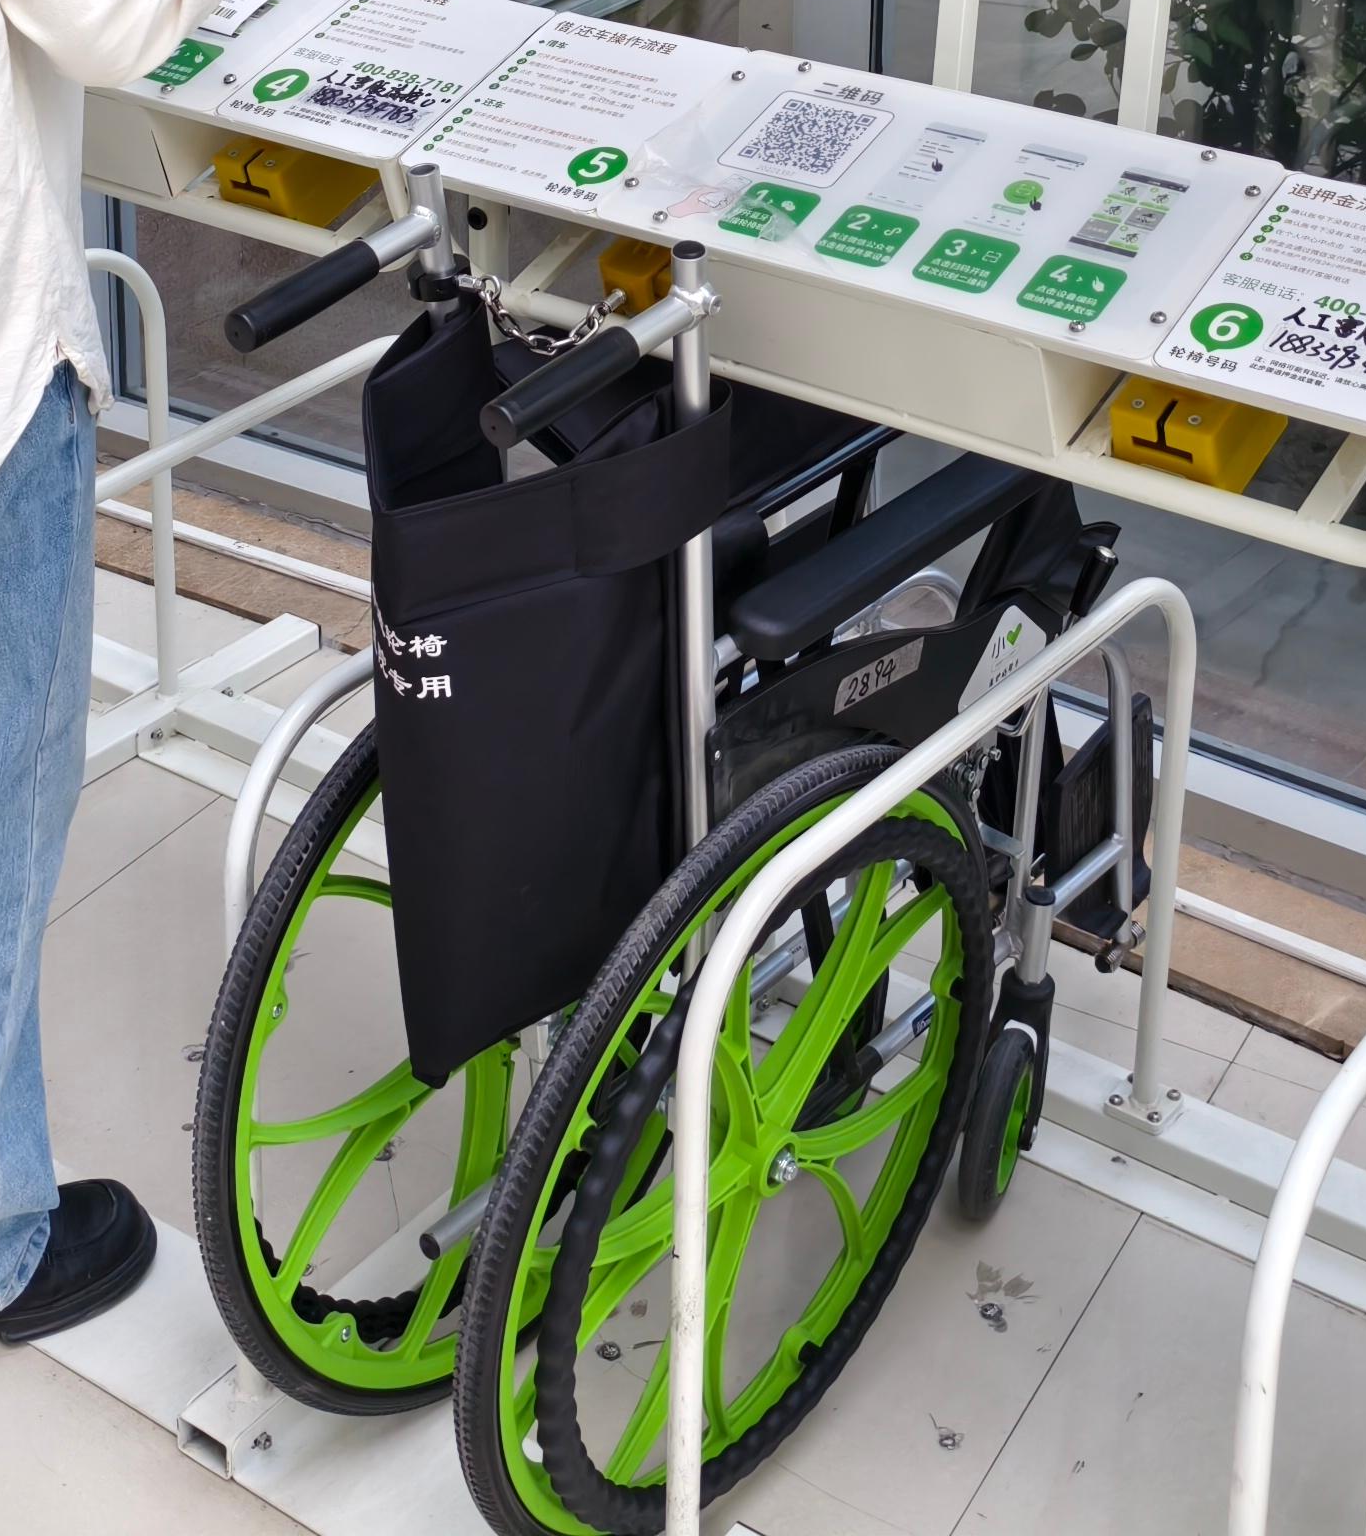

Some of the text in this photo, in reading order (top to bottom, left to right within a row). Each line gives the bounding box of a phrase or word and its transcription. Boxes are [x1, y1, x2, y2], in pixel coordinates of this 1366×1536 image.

[554, 20, 677, 56] 借/还车操作流程
[266, 75, 293, 97] 4
[352, 61, 463, 95] 400-828-7181
[814, 82, 885, 106] 二维码
[578, 152, 618, 178] 5
[545, 182, 598, 202] 轮椅号码
[847, 213, 872, 231] 2
[945, 239, 968, 257] 3
[1050, 264, 1073, 284] 4
[1208, 310, 1248, 341] 6
[1169, 346, 1239, 373] 轮椅号码
